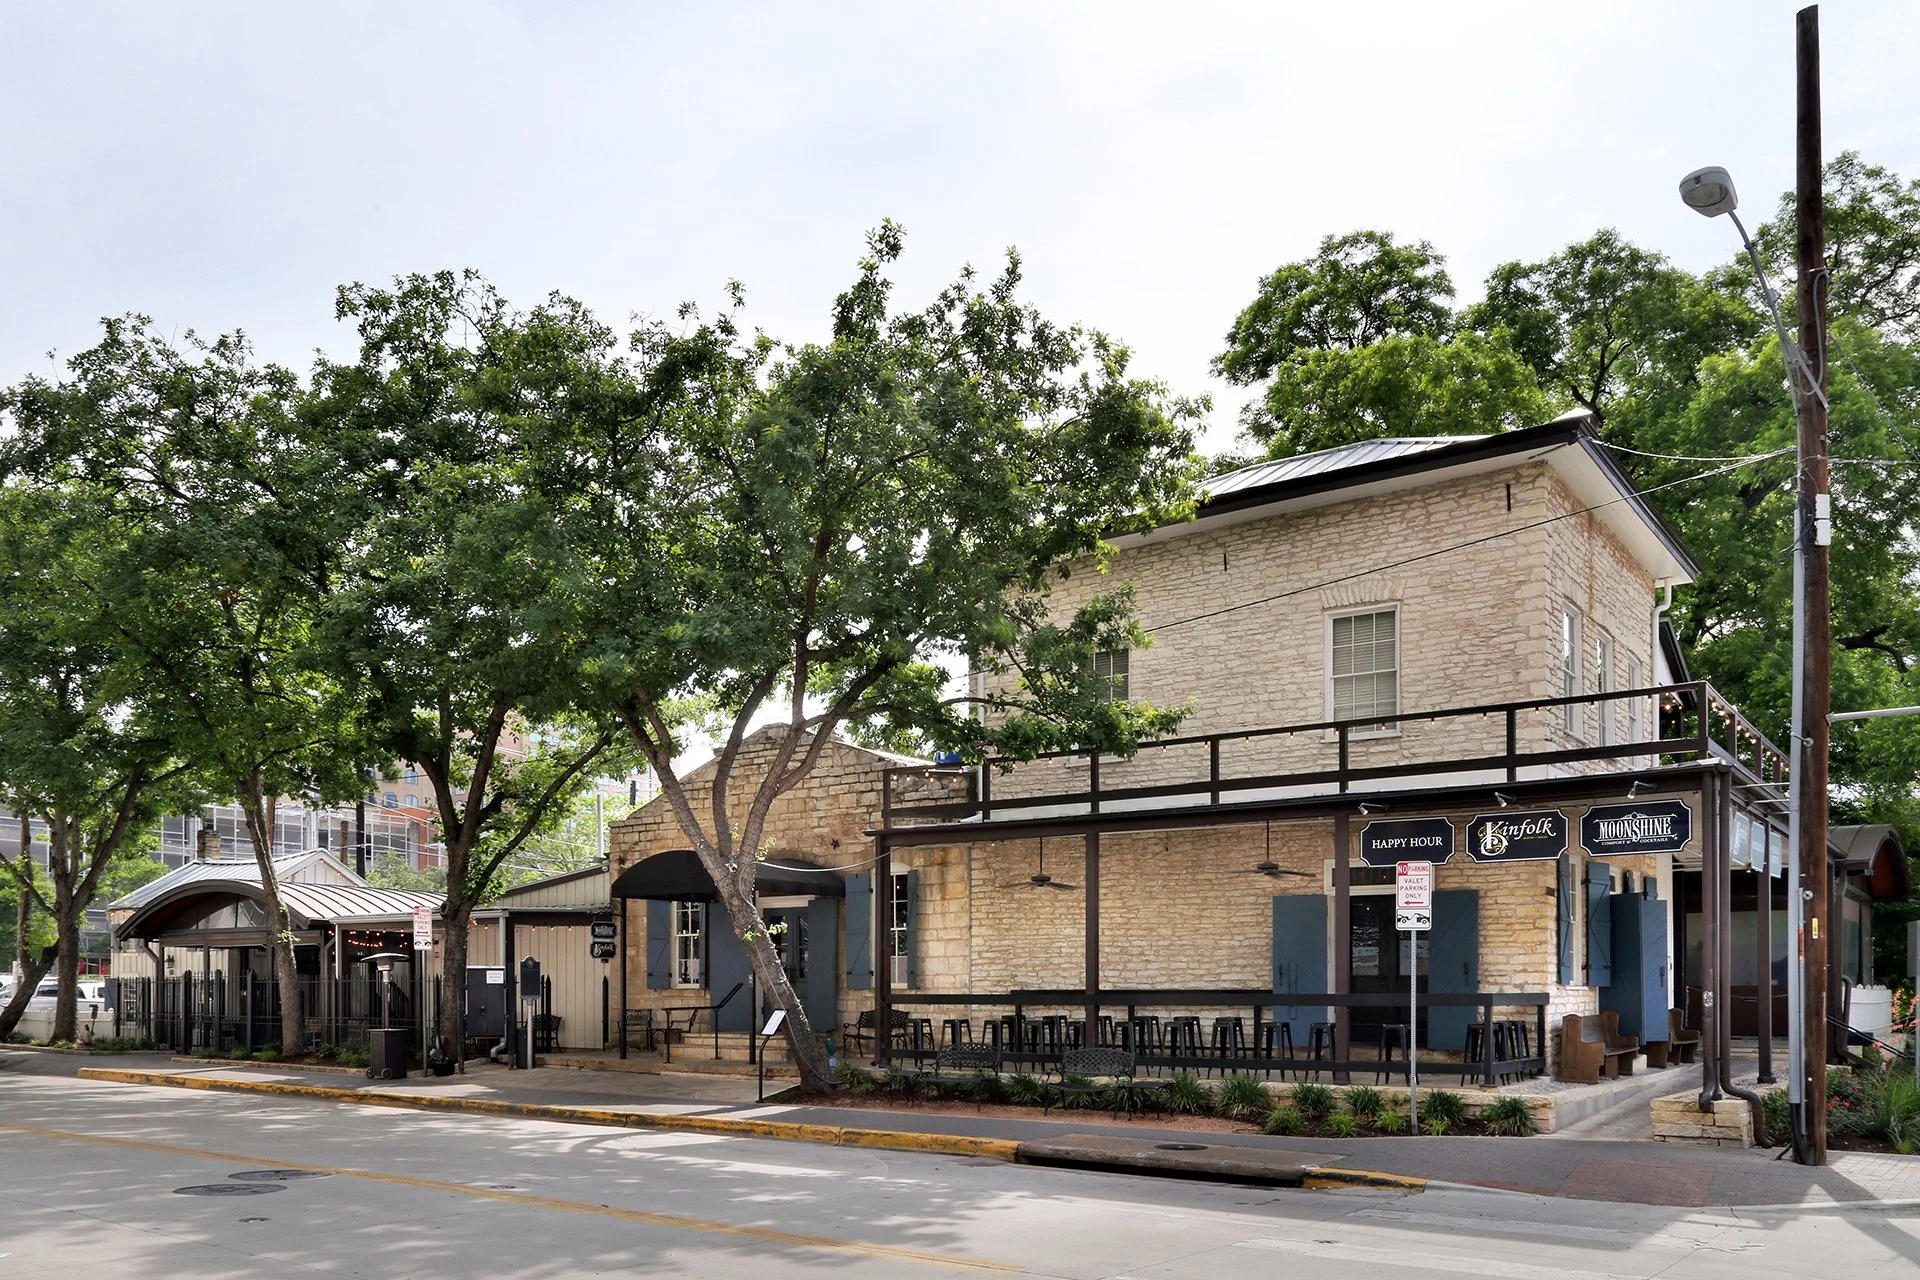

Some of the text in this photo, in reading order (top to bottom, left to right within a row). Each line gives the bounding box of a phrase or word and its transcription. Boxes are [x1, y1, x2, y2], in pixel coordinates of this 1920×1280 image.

[1480, 817, 1557, 856] Kinfolk
[1599, 817, 1672, 842] MOONSHINE
[1372, 836, 1443, 849] HAPPY HOUR
[1397, 864, 1408, 875] NO
